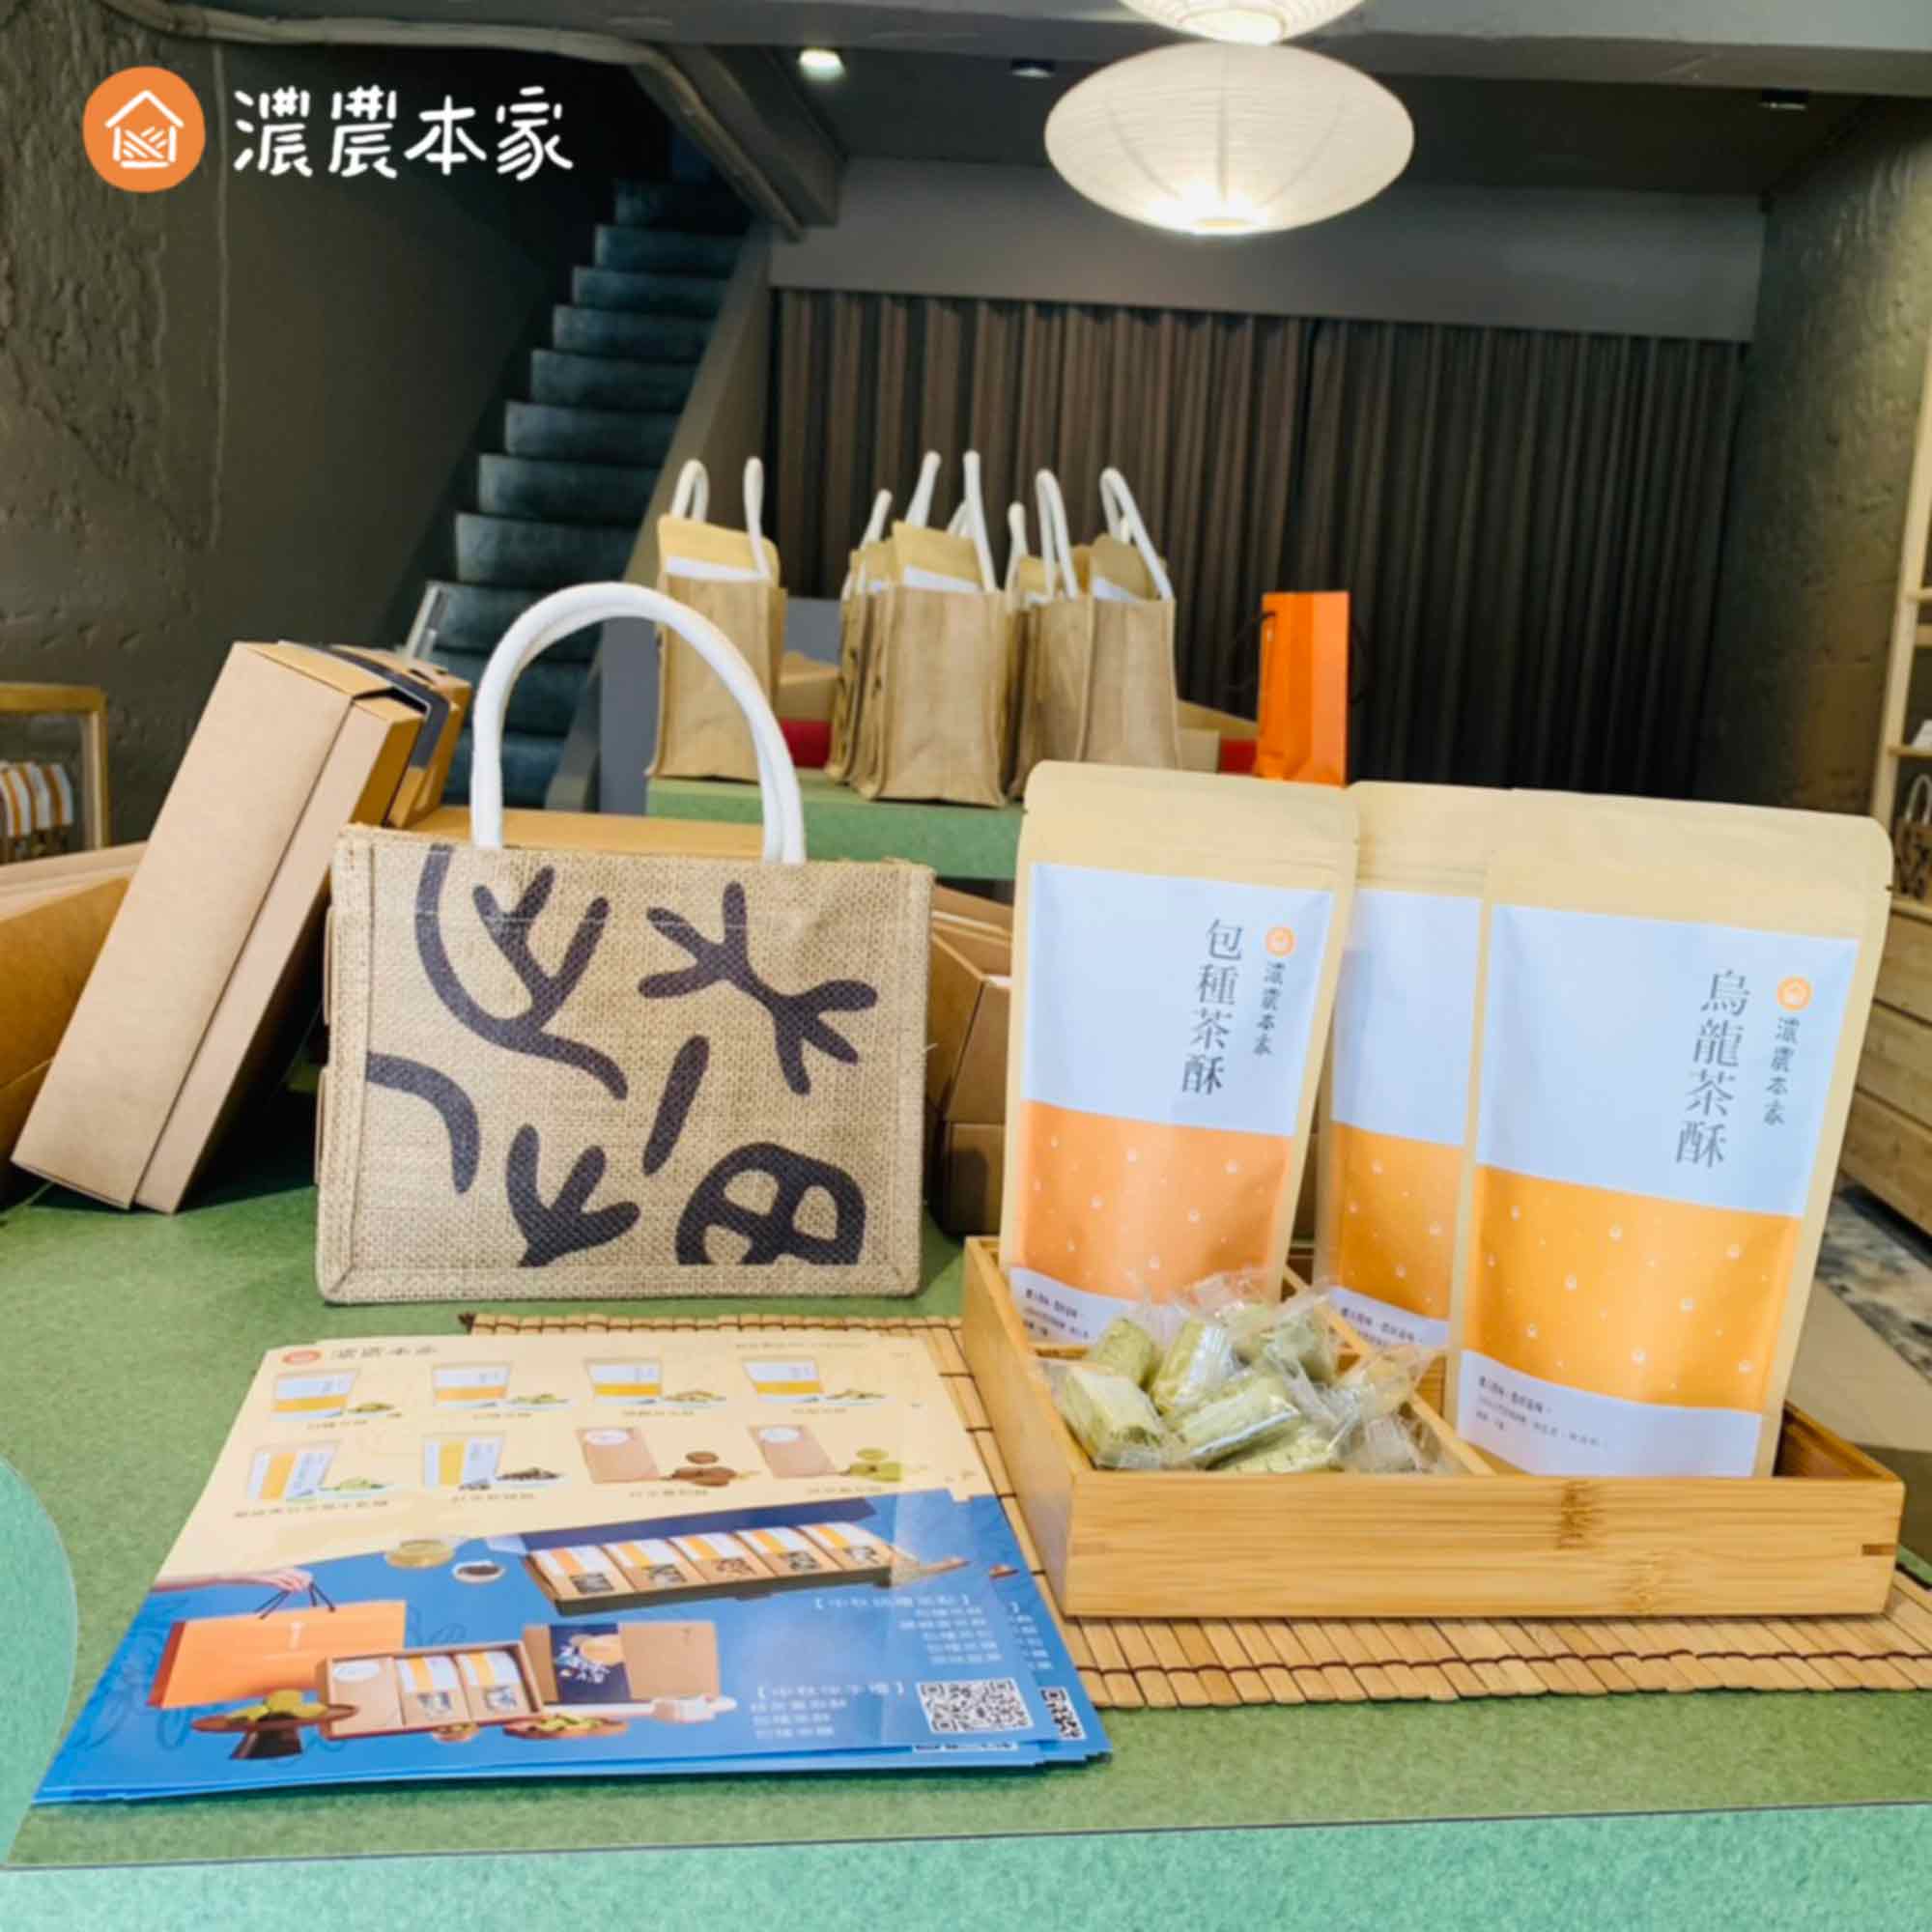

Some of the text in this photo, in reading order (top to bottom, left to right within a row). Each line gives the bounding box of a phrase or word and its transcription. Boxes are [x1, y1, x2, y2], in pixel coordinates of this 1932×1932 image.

[1181, 918, 1243, 1095] 包種茶酥
[1675, 968, 1749, 1168] 烏龍茶酥
